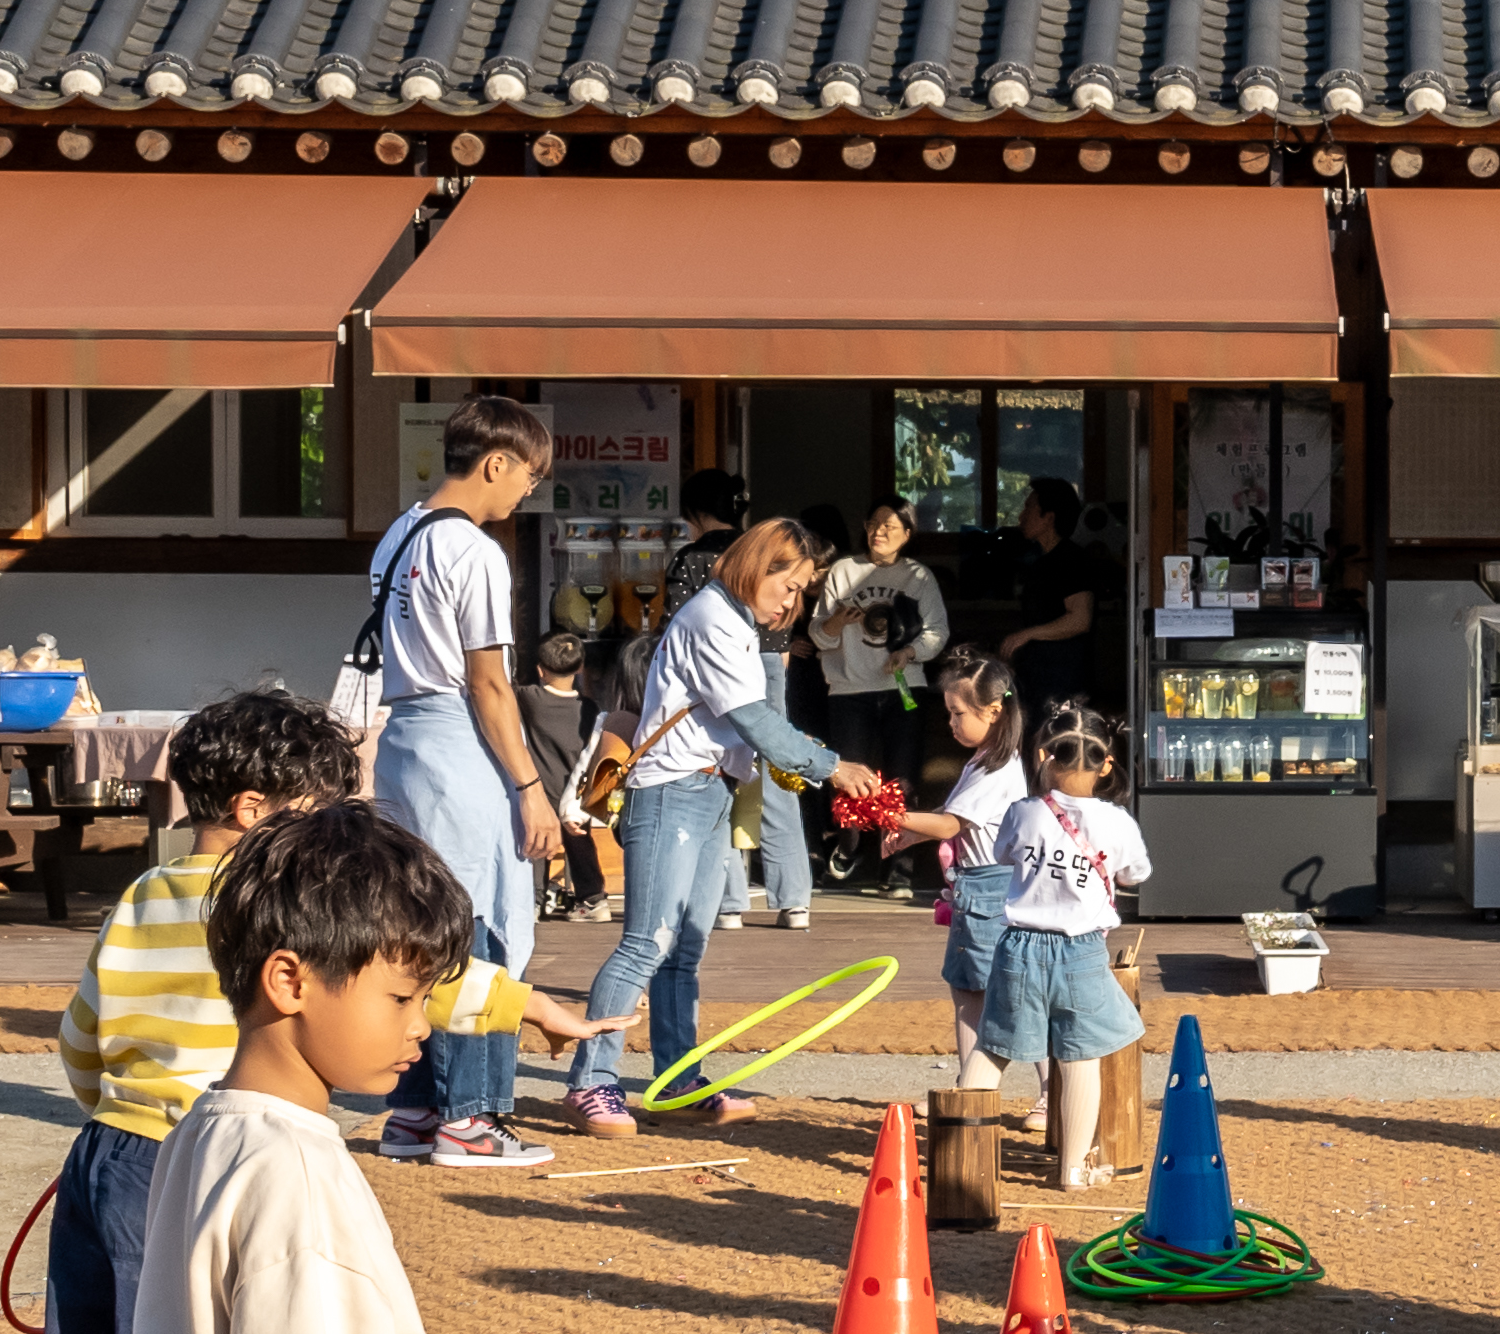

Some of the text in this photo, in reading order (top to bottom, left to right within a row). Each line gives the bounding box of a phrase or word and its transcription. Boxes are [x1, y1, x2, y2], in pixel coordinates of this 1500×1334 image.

[553, 434, 669, 462] 아이스크림
[1231, 463, 1291, 478] (만들)
[1024, 845, 1095, 889] 작은딸
